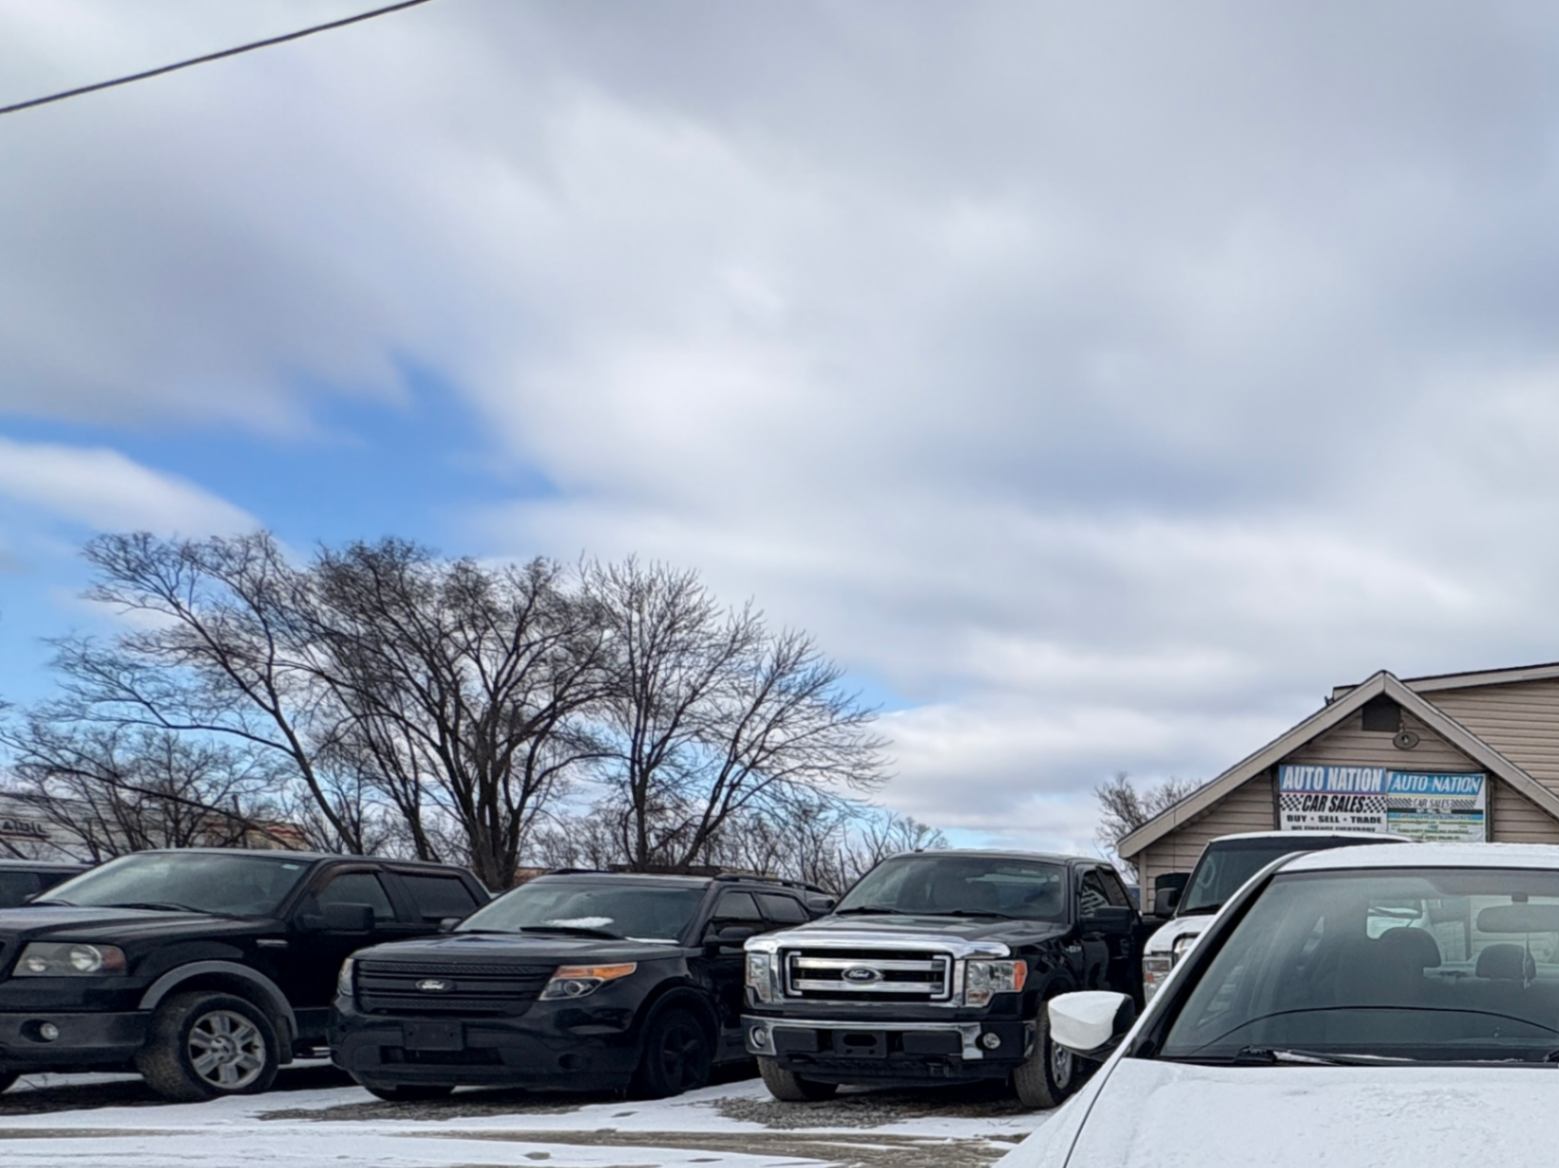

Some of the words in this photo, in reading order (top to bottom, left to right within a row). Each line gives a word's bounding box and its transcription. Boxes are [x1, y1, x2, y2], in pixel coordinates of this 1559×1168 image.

[1282, 766, 1325, 791] AUTO
[1326, 767, 1383, 792] NATION
[1391, 774, 1428, 791] AUTO
[1431, 776, 1481, 793] NATION
[1302, 794, 1328, 813] CAR
[1328, 795, 1366, 814] SALES
[1287, 814, 1307, 823] BUY
[1318, 815, 1340, 824] SELL
[1350, 816, 1382, 825] TRADE
